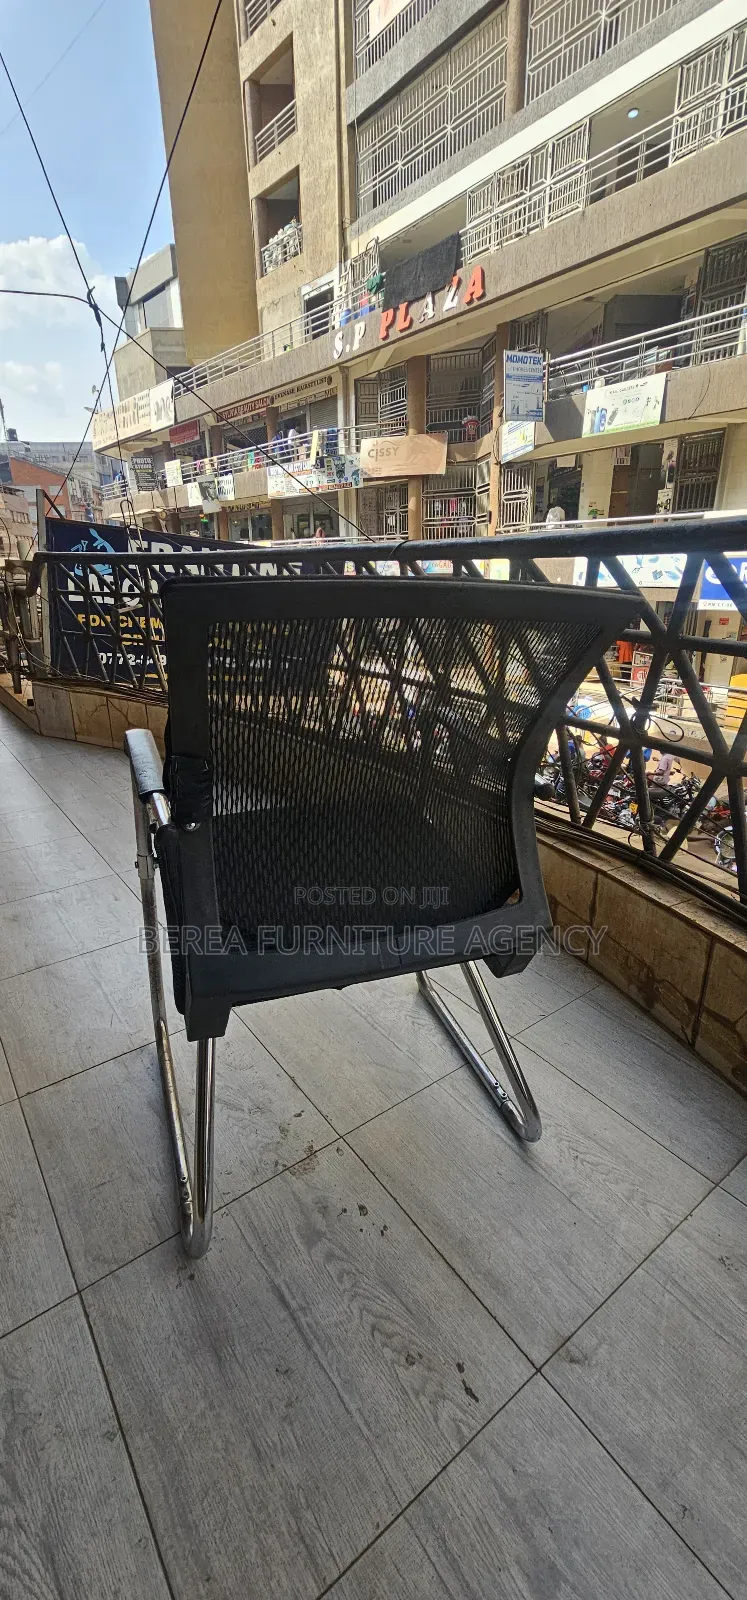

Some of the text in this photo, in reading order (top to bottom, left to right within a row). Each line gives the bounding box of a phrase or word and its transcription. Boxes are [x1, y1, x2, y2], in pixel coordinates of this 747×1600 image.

[333, 265, 484, 359] S.P PLAZA
[506, 354, 542, 366] MOMOTEK
